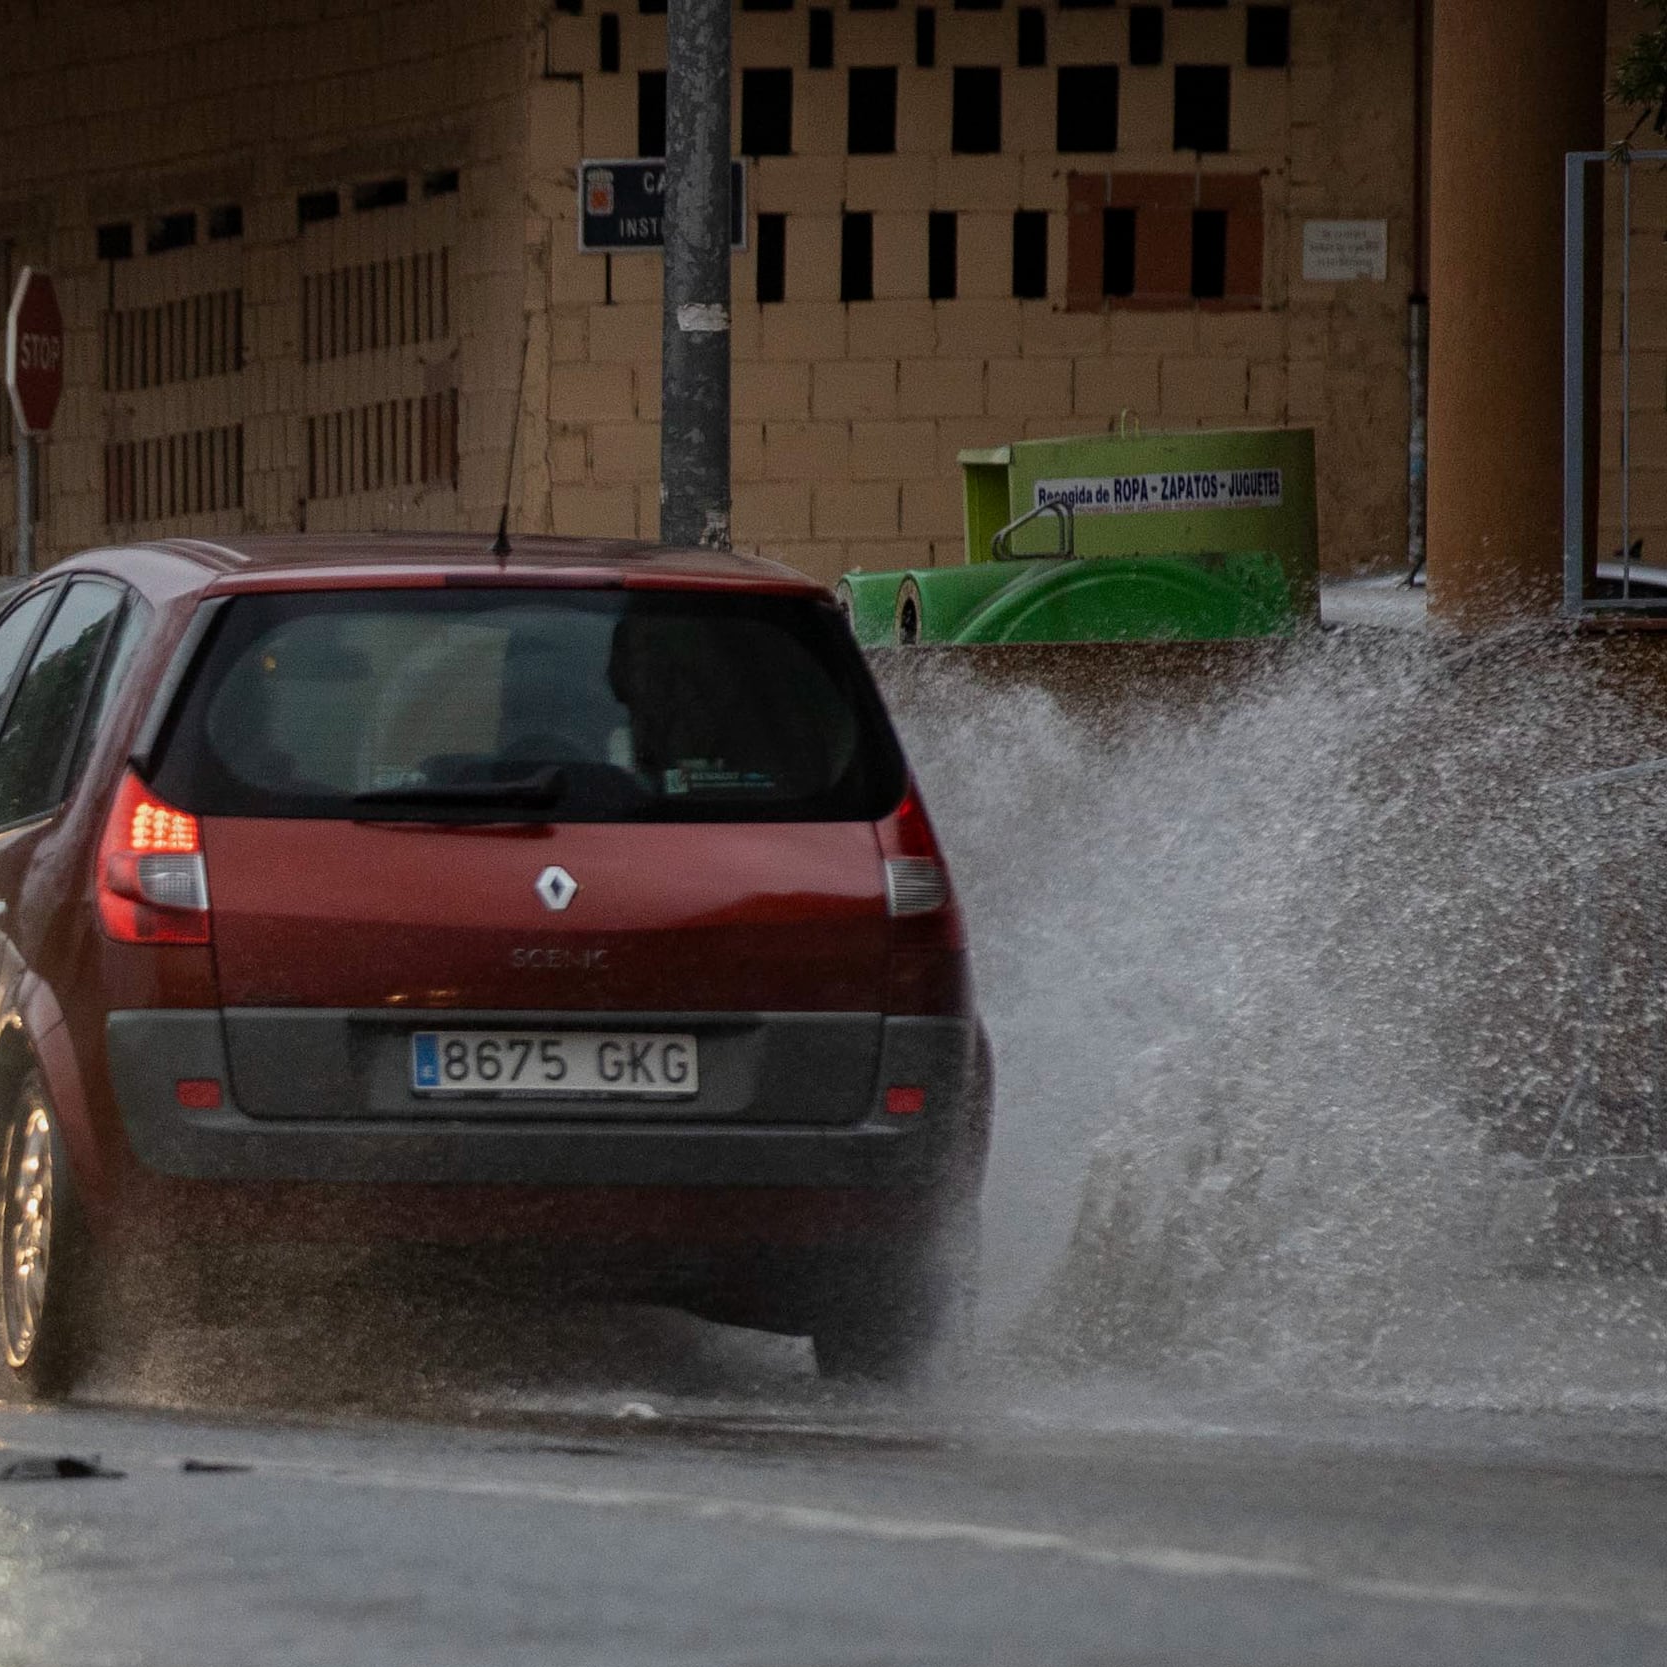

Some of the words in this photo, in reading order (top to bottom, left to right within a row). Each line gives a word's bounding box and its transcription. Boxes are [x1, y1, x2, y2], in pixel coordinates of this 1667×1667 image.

[20, 333, 60, 372] STOP
[1038, 485, 1093, 506] Recogida
[1095, 485, 1110, 503] de
[1113, 477, 1149, 503] ROPA
[1160, 474, 1218, 501] ZAPATOS
[1228, 471, 1280, 497] JUGUETES
[442, 1039, 568, 1082] 8675
[598, 1040, 690, 1084] GKG
